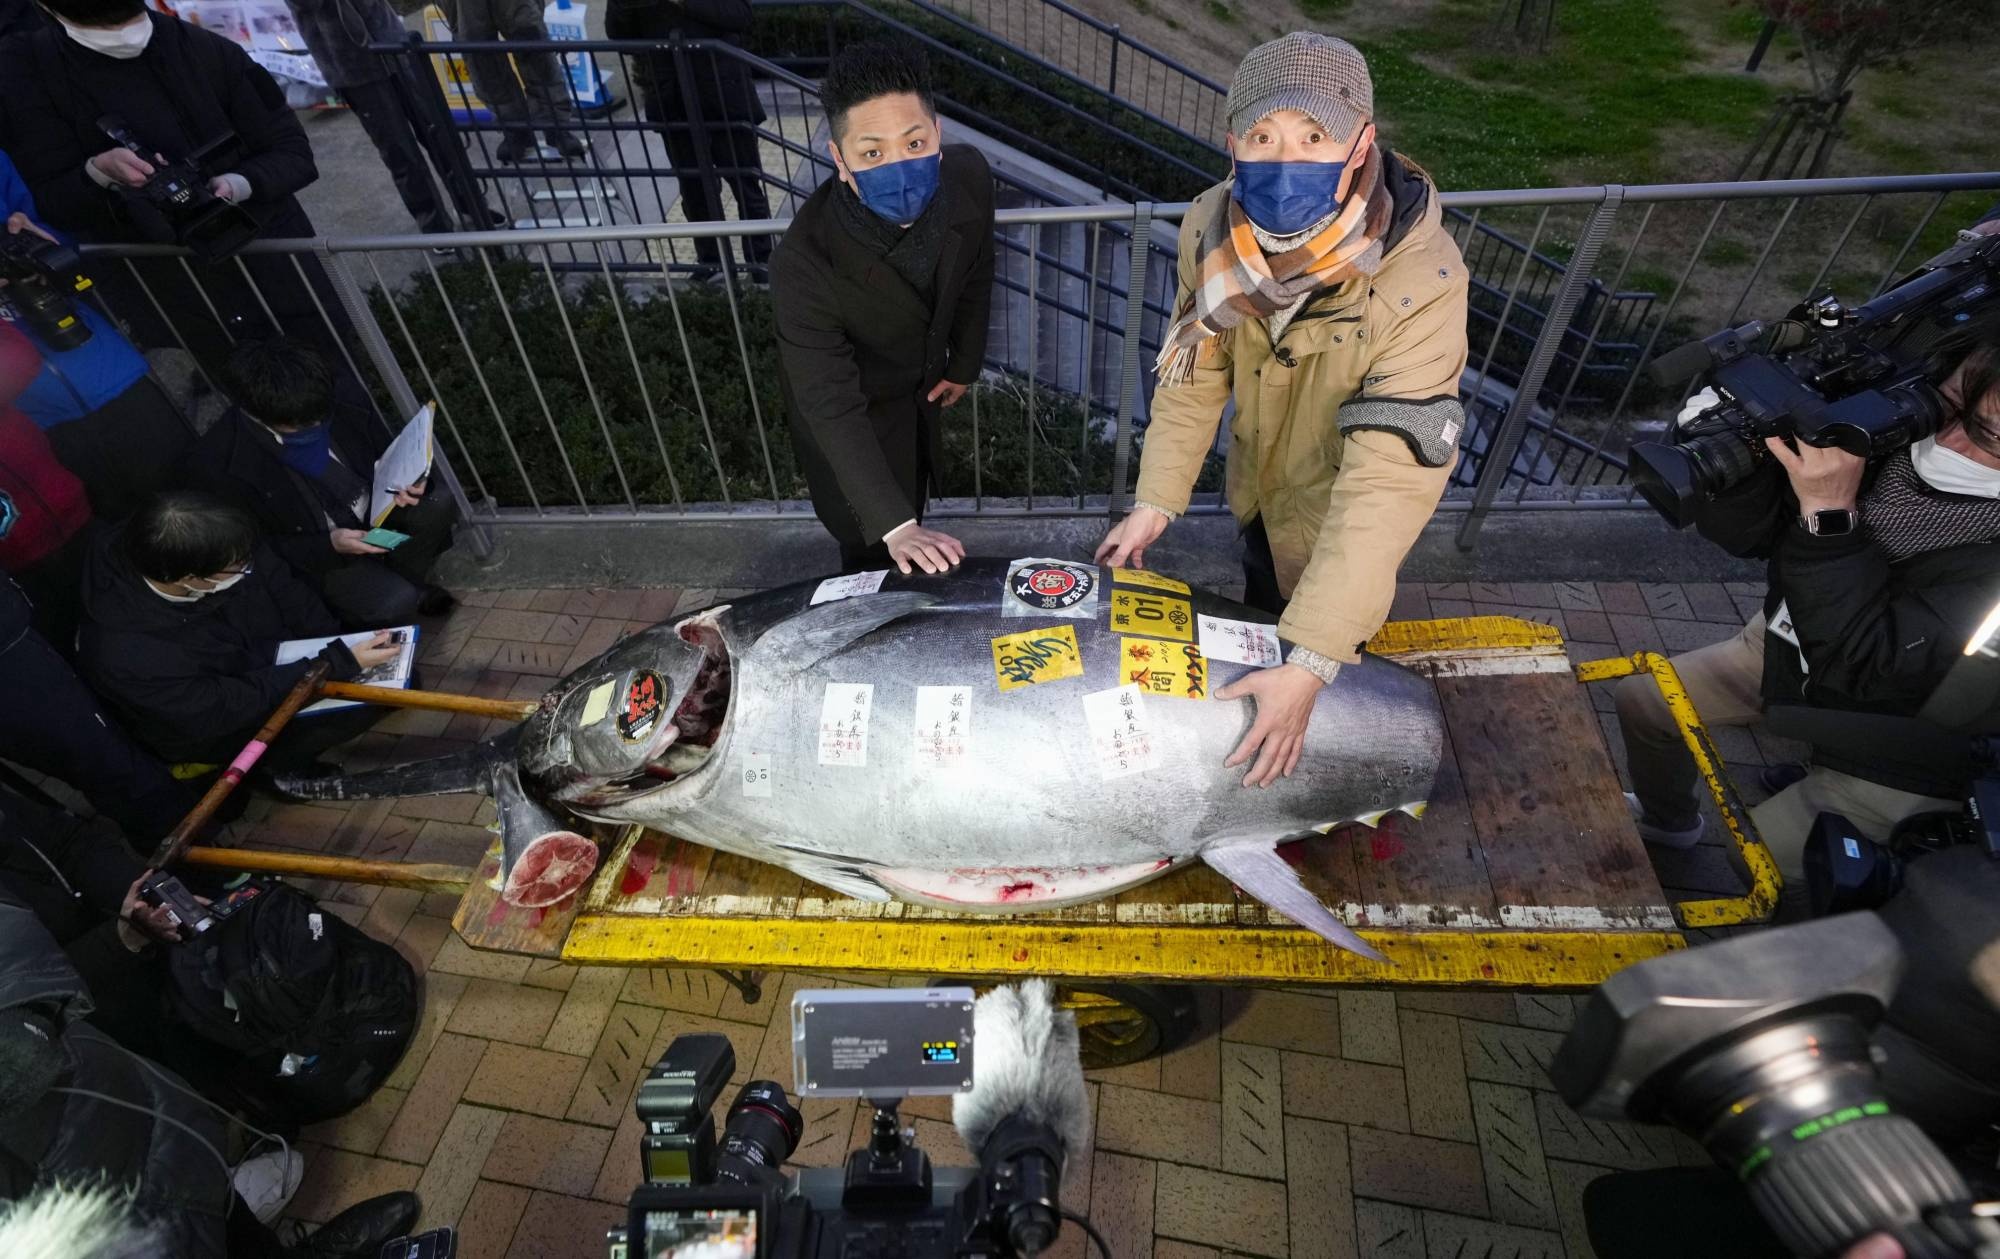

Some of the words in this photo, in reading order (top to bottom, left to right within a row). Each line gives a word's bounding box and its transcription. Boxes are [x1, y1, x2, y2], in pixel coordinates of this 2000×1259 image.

[1134, 597, 1164, 622] 01
[997, 642, 1015, 666] 01
[760, 767, 767, 780] 01
